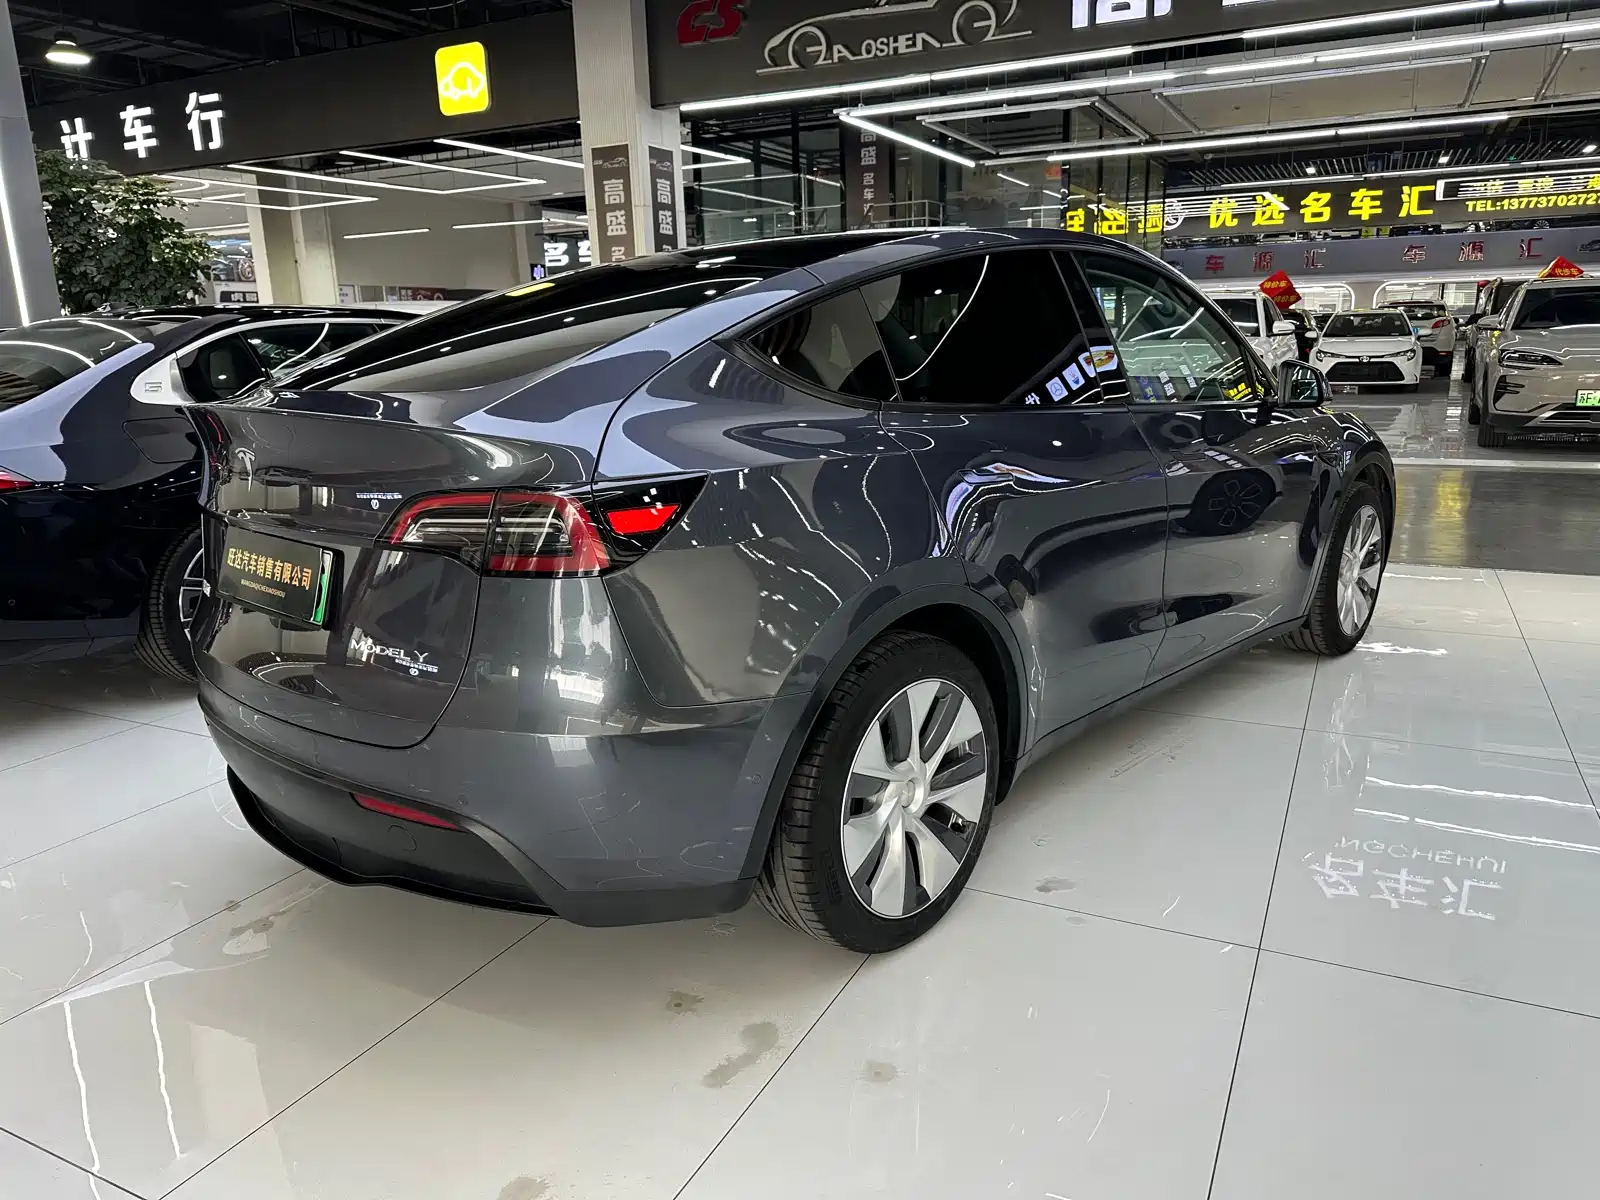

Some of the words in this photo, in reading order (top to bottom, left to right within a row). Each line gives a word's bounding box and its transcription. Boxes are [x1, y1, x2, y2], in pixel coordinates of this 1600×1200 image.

[1208, 185, 1436, 229] 优选名车汇
[227, 547, 312, 591] 旺达汽车销售有限公司
[350, 638, 411, 660] MODEL
[413, 650, 429, 663] Y
